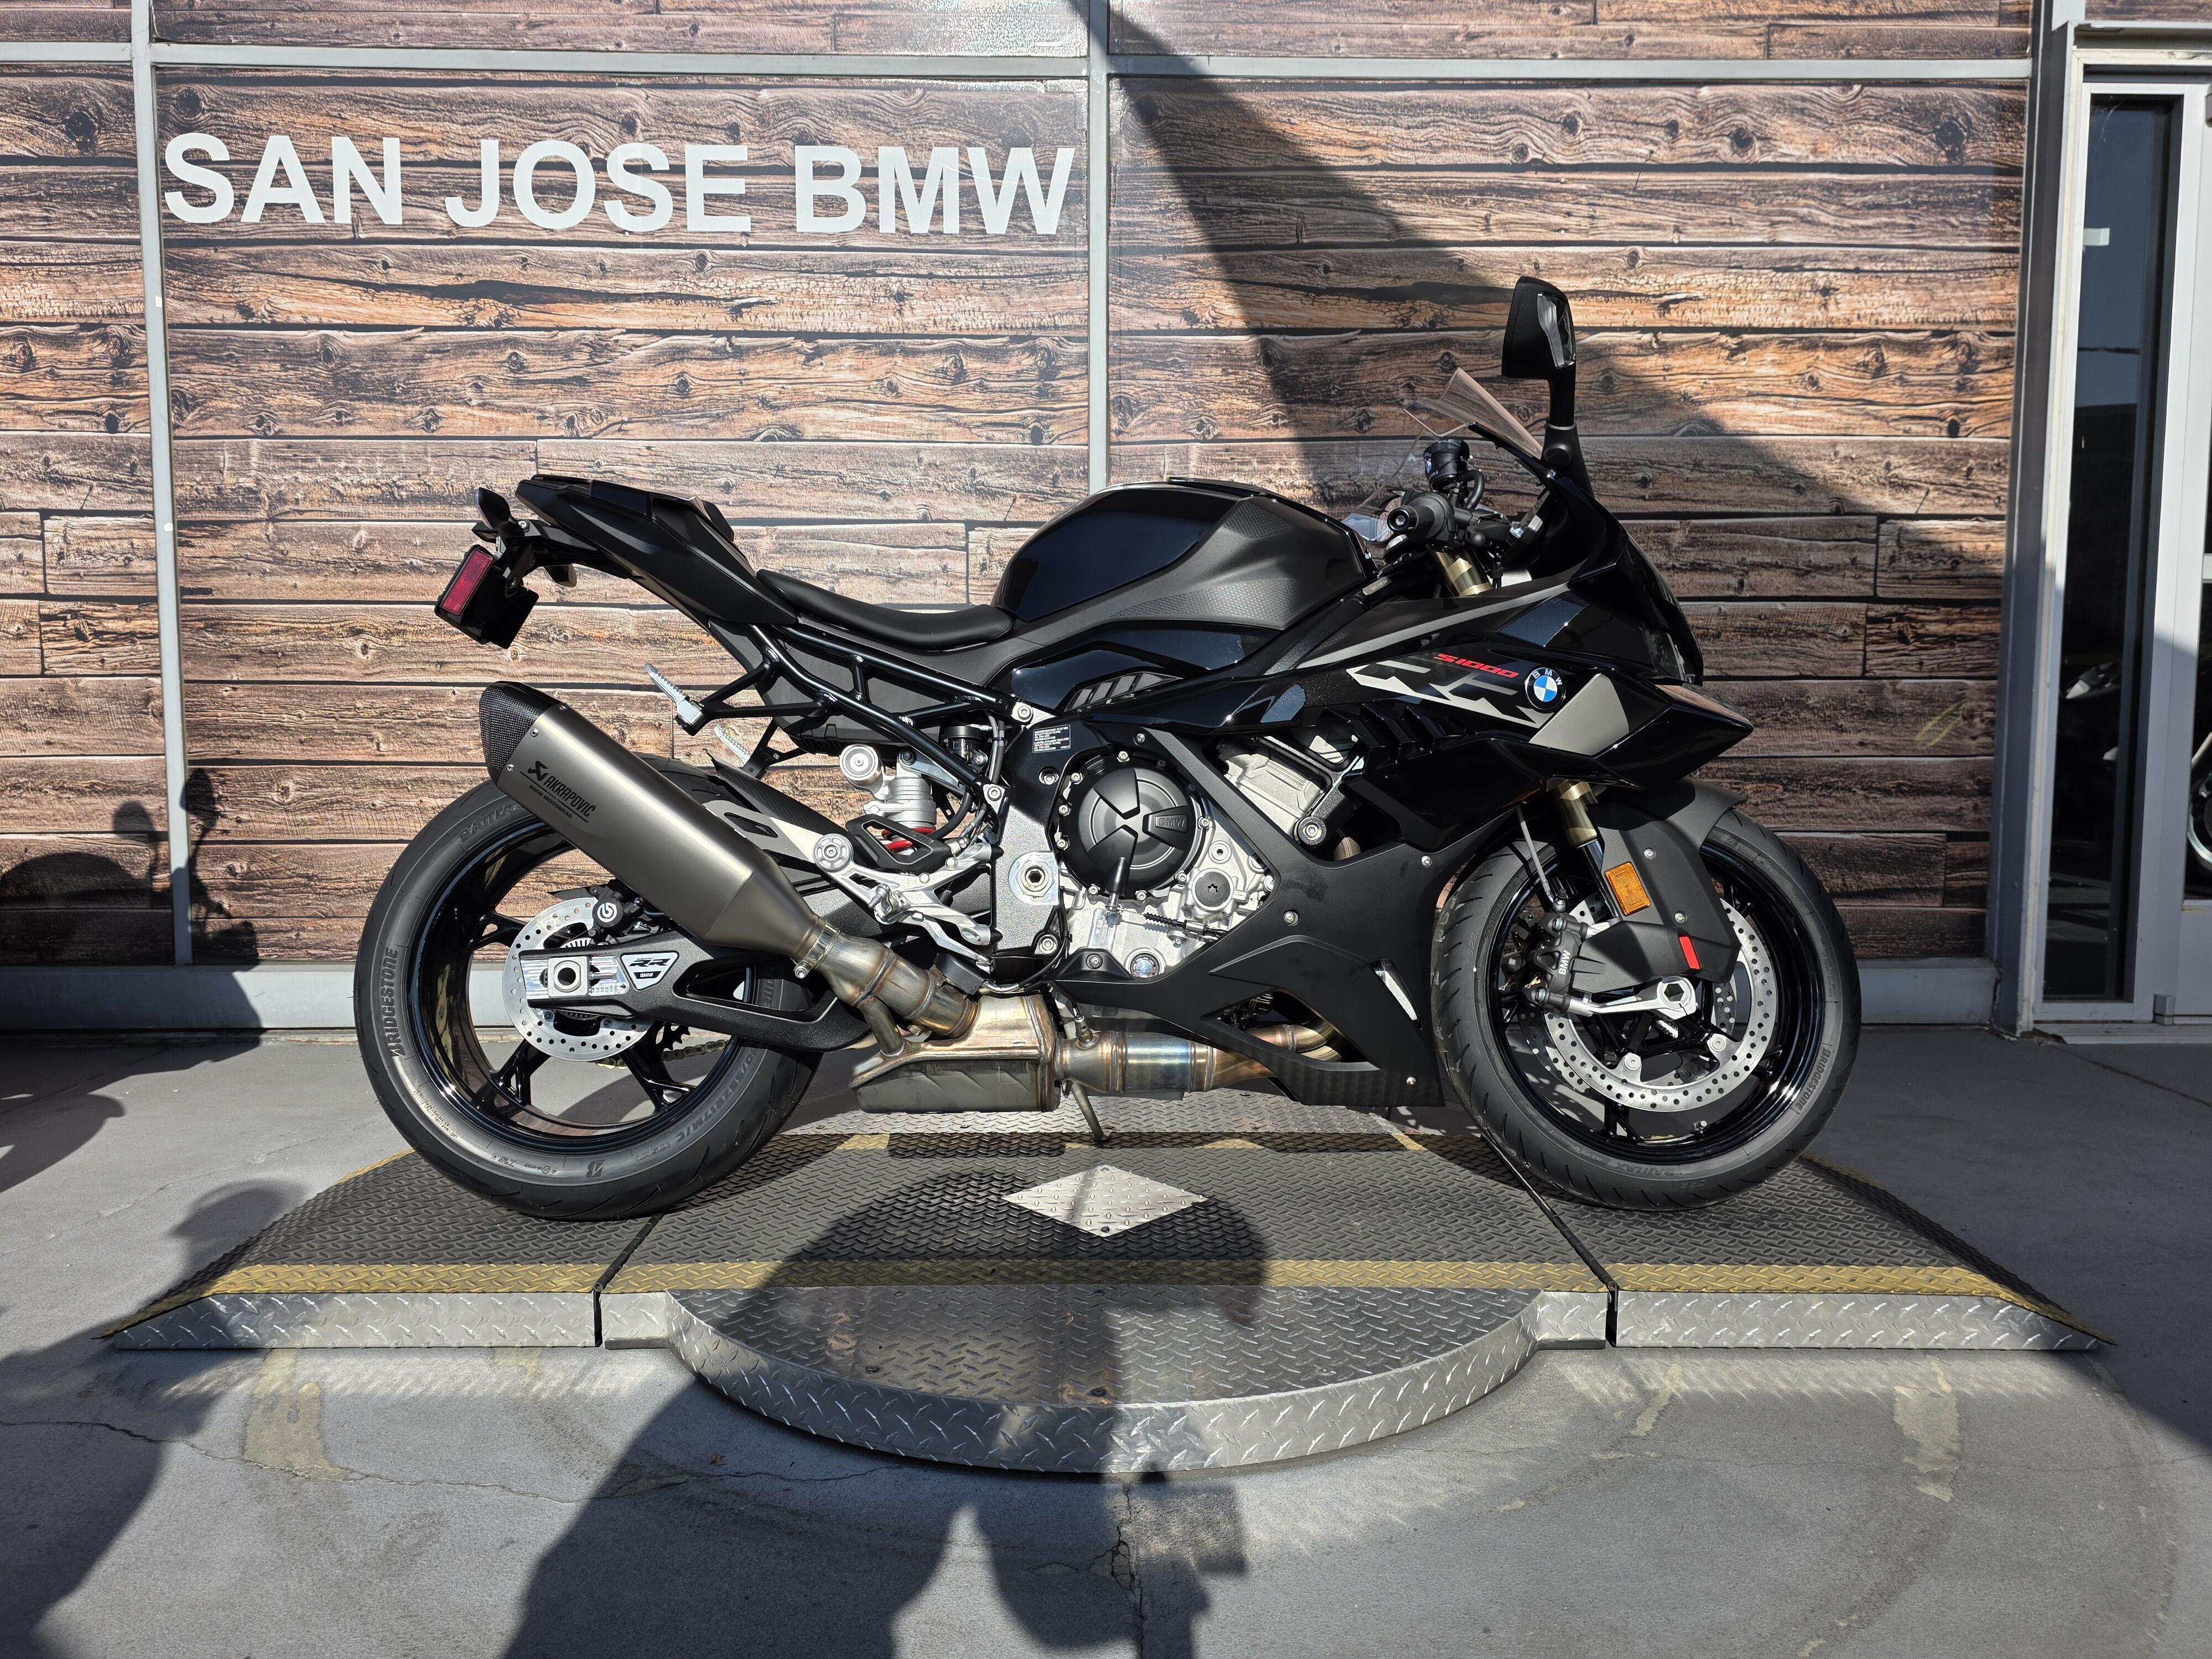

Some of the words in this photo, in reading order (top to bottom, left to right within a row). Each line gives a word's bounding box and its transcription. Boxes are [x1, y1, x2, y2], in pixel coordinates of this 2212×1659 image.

[164, 133, 403, 225] SAN
[445, 138, 751, 233] JOSE
[794, 145, 1076, 235] BMW
[1433, 653, 1519, 678] S1000
[1532, 668, 1563, 686] BMW
[529, 784, 543, 796] BMW
[543, 795, 572, 818] MOTORRAD
[1159, 817, 1186, 827] BMW
[1558, 950, 1571, 975] BMW
[380, 947, 406, 1057] BRIDGESTONE
[1795, 1047, 1832, 1112] BRIDGESTONE
